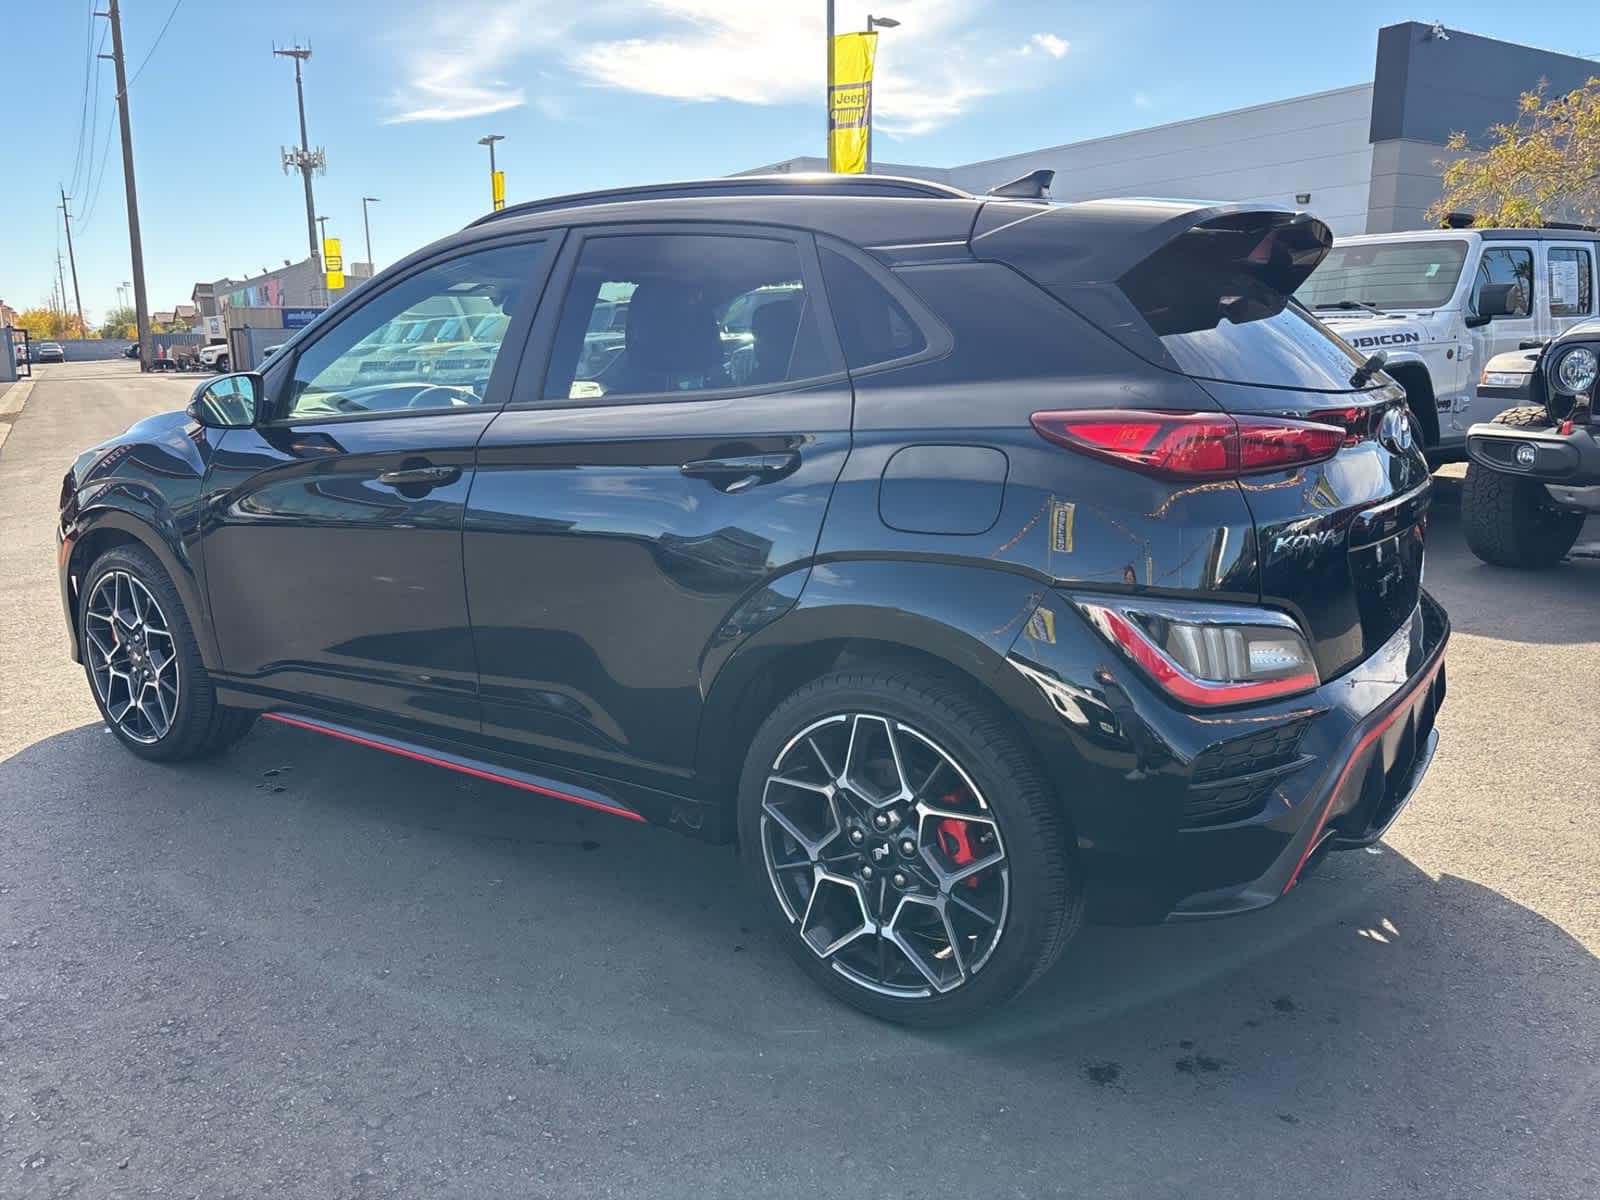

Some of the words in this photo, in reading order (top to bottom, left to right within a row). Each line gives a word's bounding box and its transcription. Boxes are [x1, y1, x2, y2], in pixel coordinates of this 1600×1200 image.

[836, 93, 865, 105] Jeep
[1352, 332, 1420, 348] BICON
[1273, 529, 1340, 552] KONA
